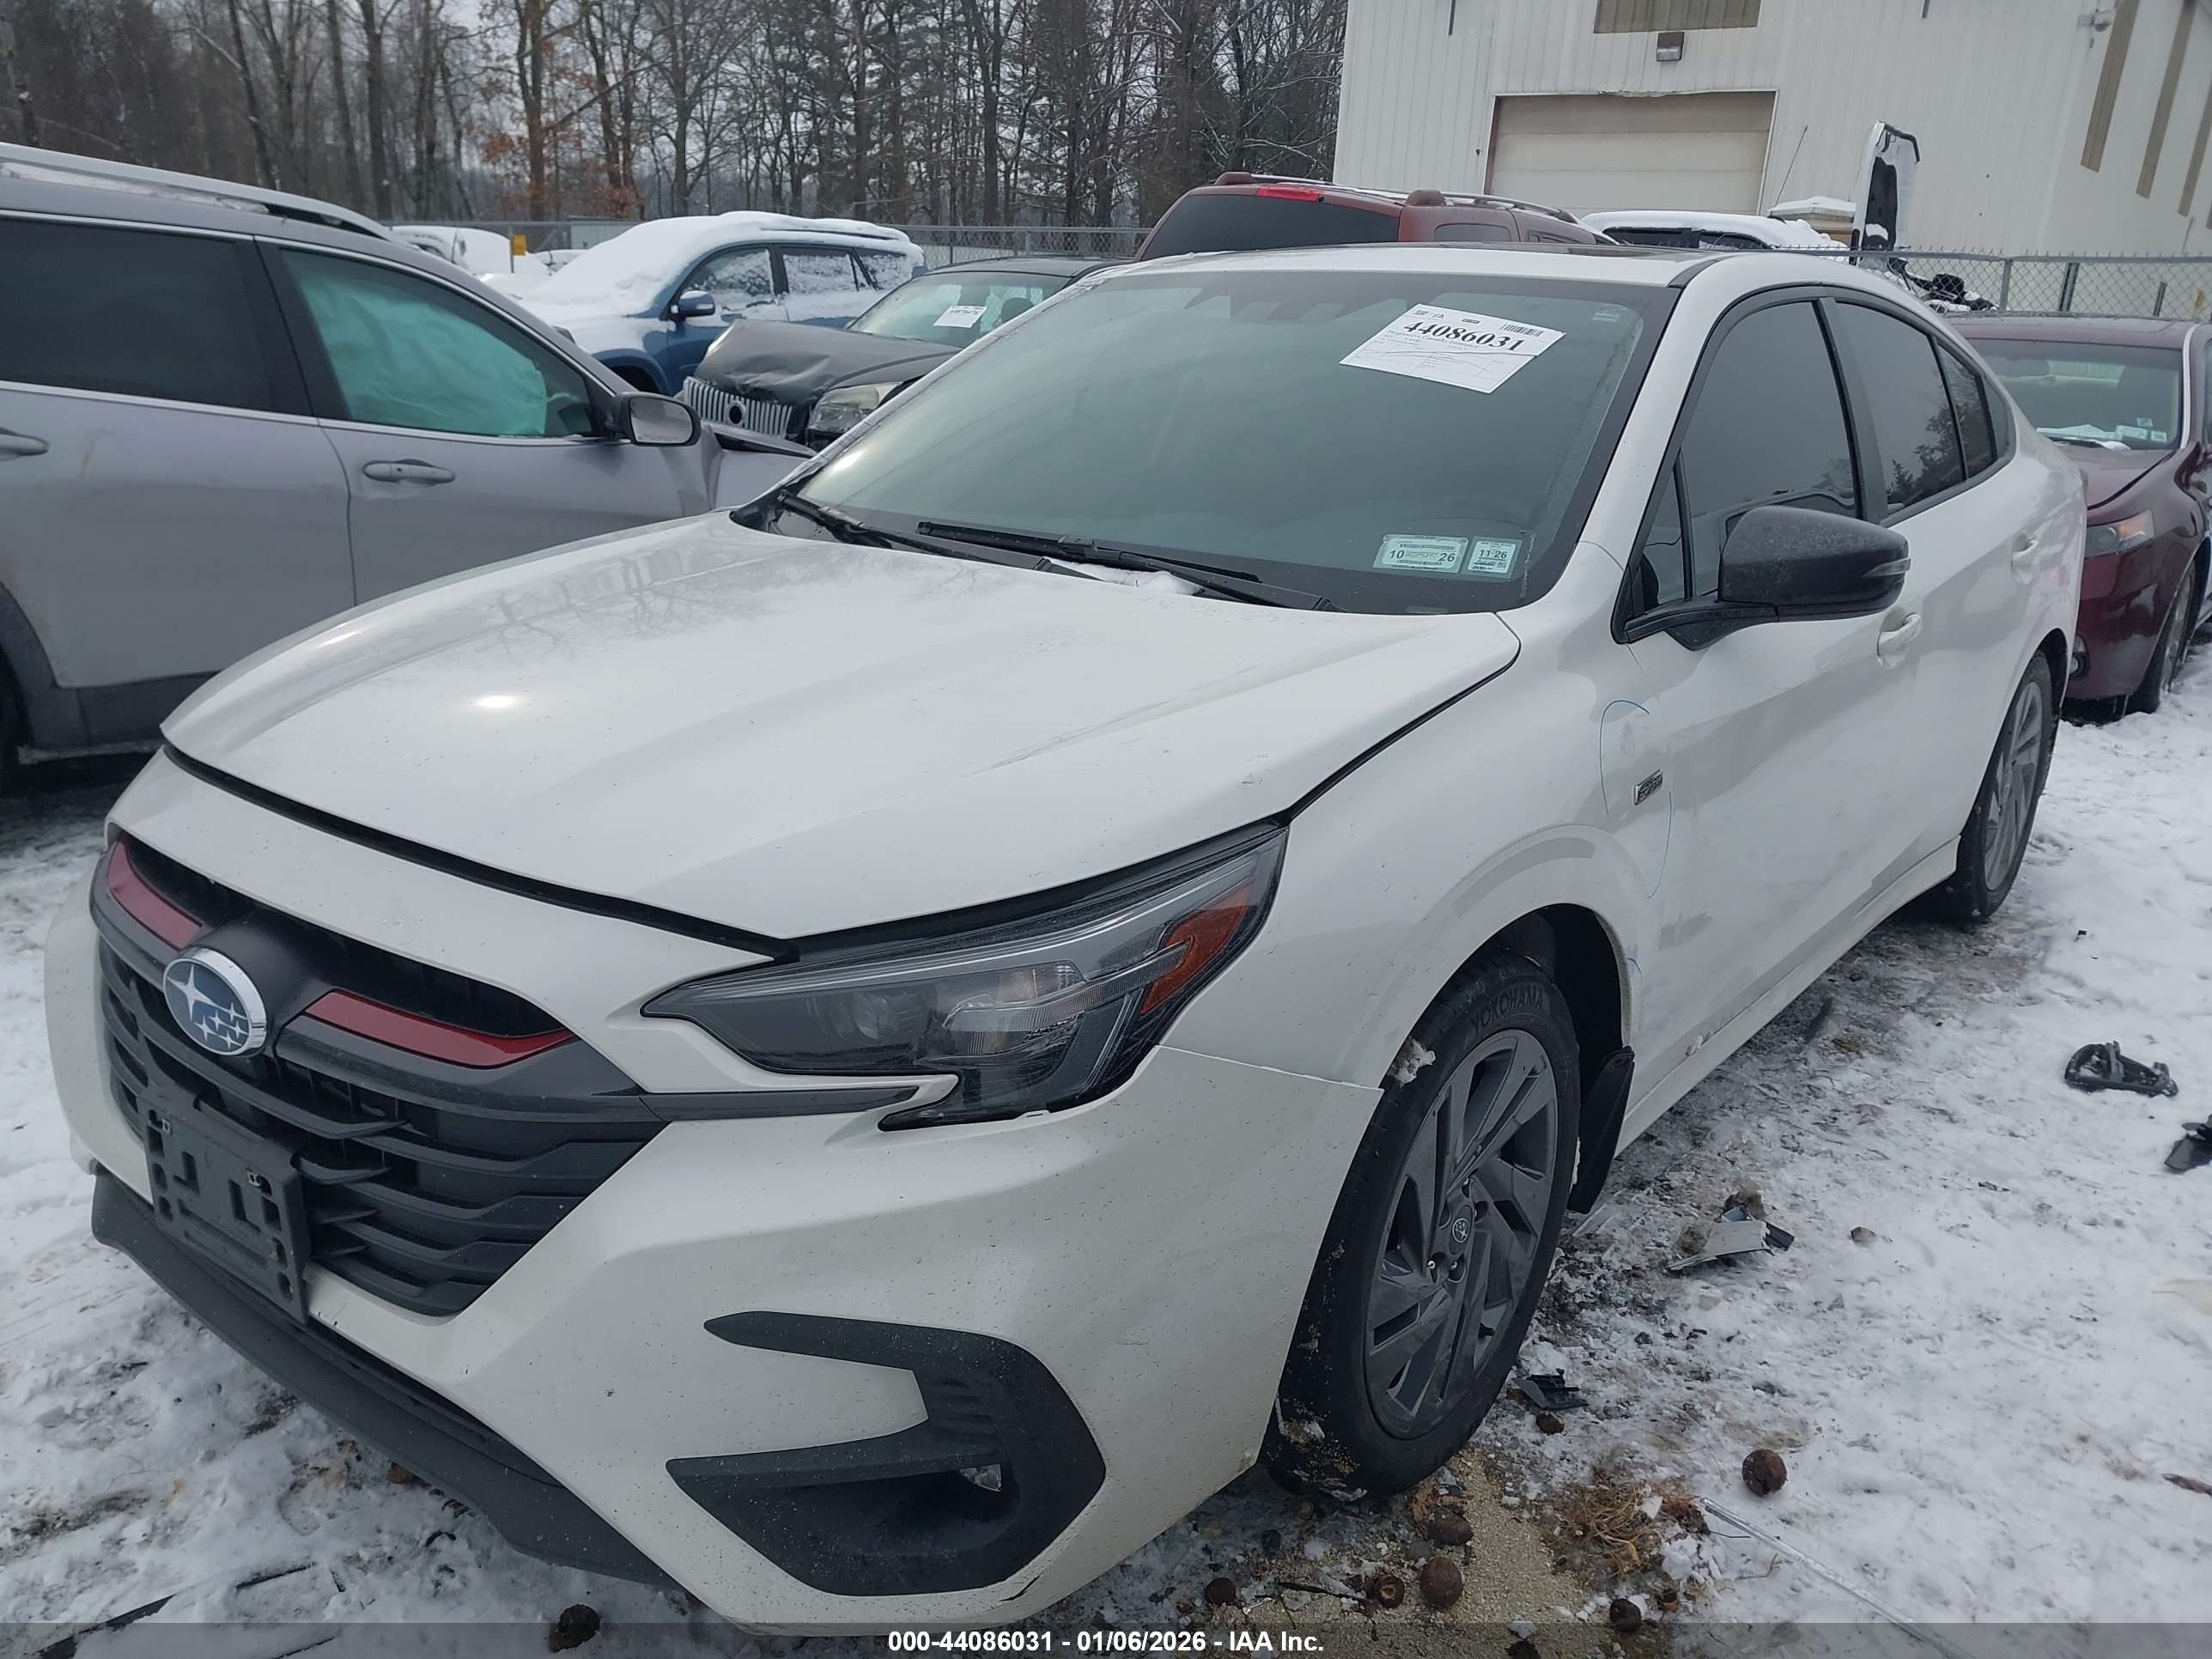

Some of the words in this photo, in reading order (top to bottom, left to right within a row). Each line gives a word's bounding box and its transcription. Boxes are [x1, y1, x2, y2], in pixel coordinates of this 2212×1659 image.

[1403, 321, 1525, 351] 44086031
[1389, 550, 1405, 559] 10
[1438, 552, 1455, 562] 26
[1470, 986, 1544, 1036] YOKOHAMA
